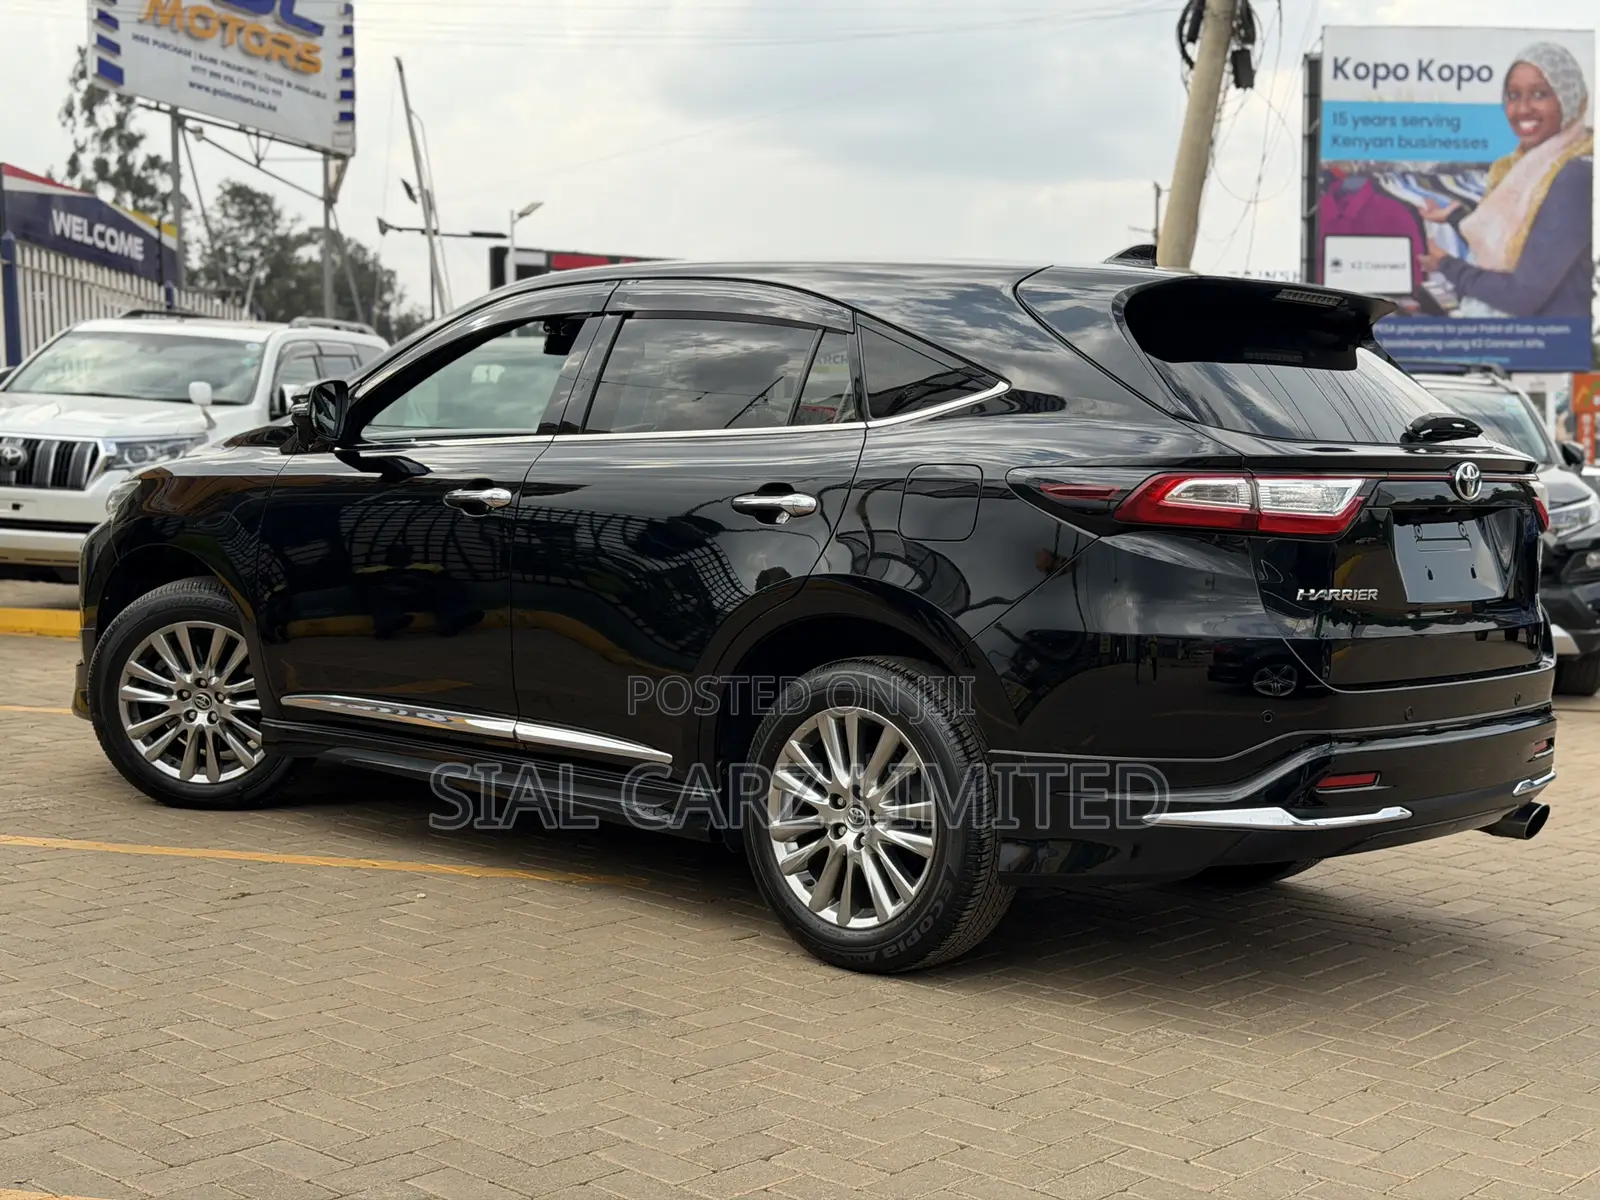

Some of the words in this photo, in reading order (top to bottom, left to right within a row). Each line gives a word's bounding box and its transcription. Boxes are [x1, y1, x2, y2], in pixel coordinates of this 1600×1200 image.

[143, 0, 322, 74] MOTORS
[1332, 56, 1410, 90] Kopo
[1417, 58, 1493, 92] Kopo
[1332, 112, 1348, 127] 15
[1352, 115, 1397, 131] years
[1401, 114, 1461, 133] serving
[1331, 135, 1394, 151] Kenyan
[1398, 135, 1489, 150] businesses
[52, 209, 144, 261] WELCOME
[1296, 588, 1379, 601] HARRIER
